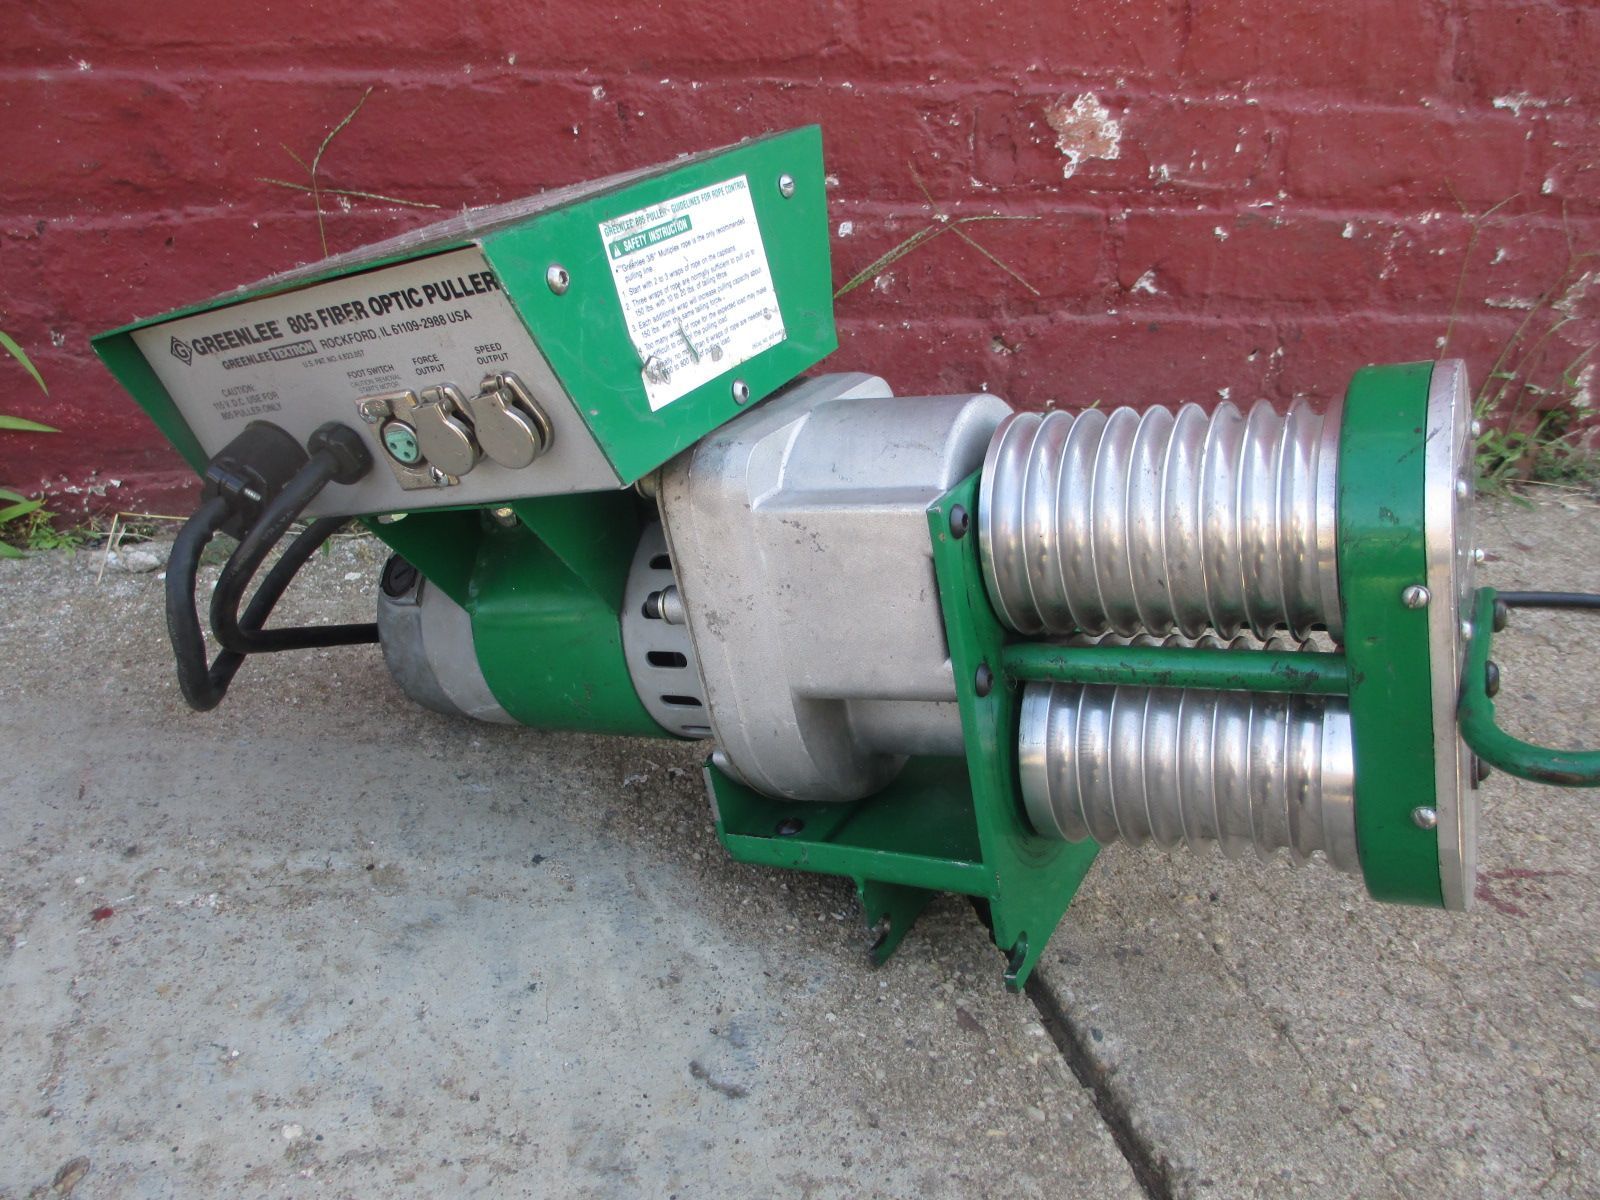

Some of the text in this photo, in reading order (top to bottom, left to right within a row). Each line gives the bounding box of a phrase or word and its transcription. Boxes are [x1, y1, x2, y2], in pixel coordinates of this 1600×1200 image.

[670, 197, 700, 213] GUIDELINES
[700, 192, 711, 202] FOR
[711, 187, 724, 199] ROPE
[724, 181, 745, 194] CONTROL
[622, 220, 688, 252] SAFETY INSTRUCTION
[680, 240, 692, 250] rope
[696, 233, 704, 241] the
[704, 229, 715, 239] only
[715, 218, 745, 234] recommended
[624, 271, 643, 284] pulling
[627, 284, 641, 296] Start
[641, 280, 653, 290] with
[668, 267, 684, 280] wraps
[689, 260, 701, 270] rope
[707, 252, 716, 261] the
[631, 295, 647, 307] Three
[648, 290, 663, 301] wraps
[669, 282, 681, 293] rope
[681, 277, 690, 285] are
[735, 252, 744, 263] pull
[637, 317, 651, 329] Each
[651, 308, 676, 323] additional
[676, 301, 689, 312] wrap
[731, 273, 749, 286] capacity
[749, 267, 761, 277] about
[655, 298, 665, 308] with
[191, 272, 500, 356] GREENLEE 805 FIBER OPTIC PULLER
[644, 341, 654, 351] Too
[654, 335, 669, 348] many
[689, 319, 701, 329] rope
[700, 314, 708, 323] for
[707, 309, 716, 319] the
[736, 296, 746, 306] load
[745, 292, 756, 302] may
[661, 319, 671, 329] with
[681, 309, 694, 319] same
[222, 309, 472, 370] GREENLEE TEXTRON ROCKFORD, IL 61109-2988 USA
[692, 327, 701, 337] the
[709, 330, 723, 342] wraps
[729, 322, 739, 332] rope
[739, 318, 747, 326] are
[412, 354, 440, 366] FORCE
[474, 343, 502, 355] SPEED
[476, 353, 510, 365] OUTPUT
[347, 364, 395, 380] FOOT SWITCH
[415, 364, 446, 376] OUTPUT
[235, 405, 263, 418] PULLER
[263, 402, 282, 413] ONLY
